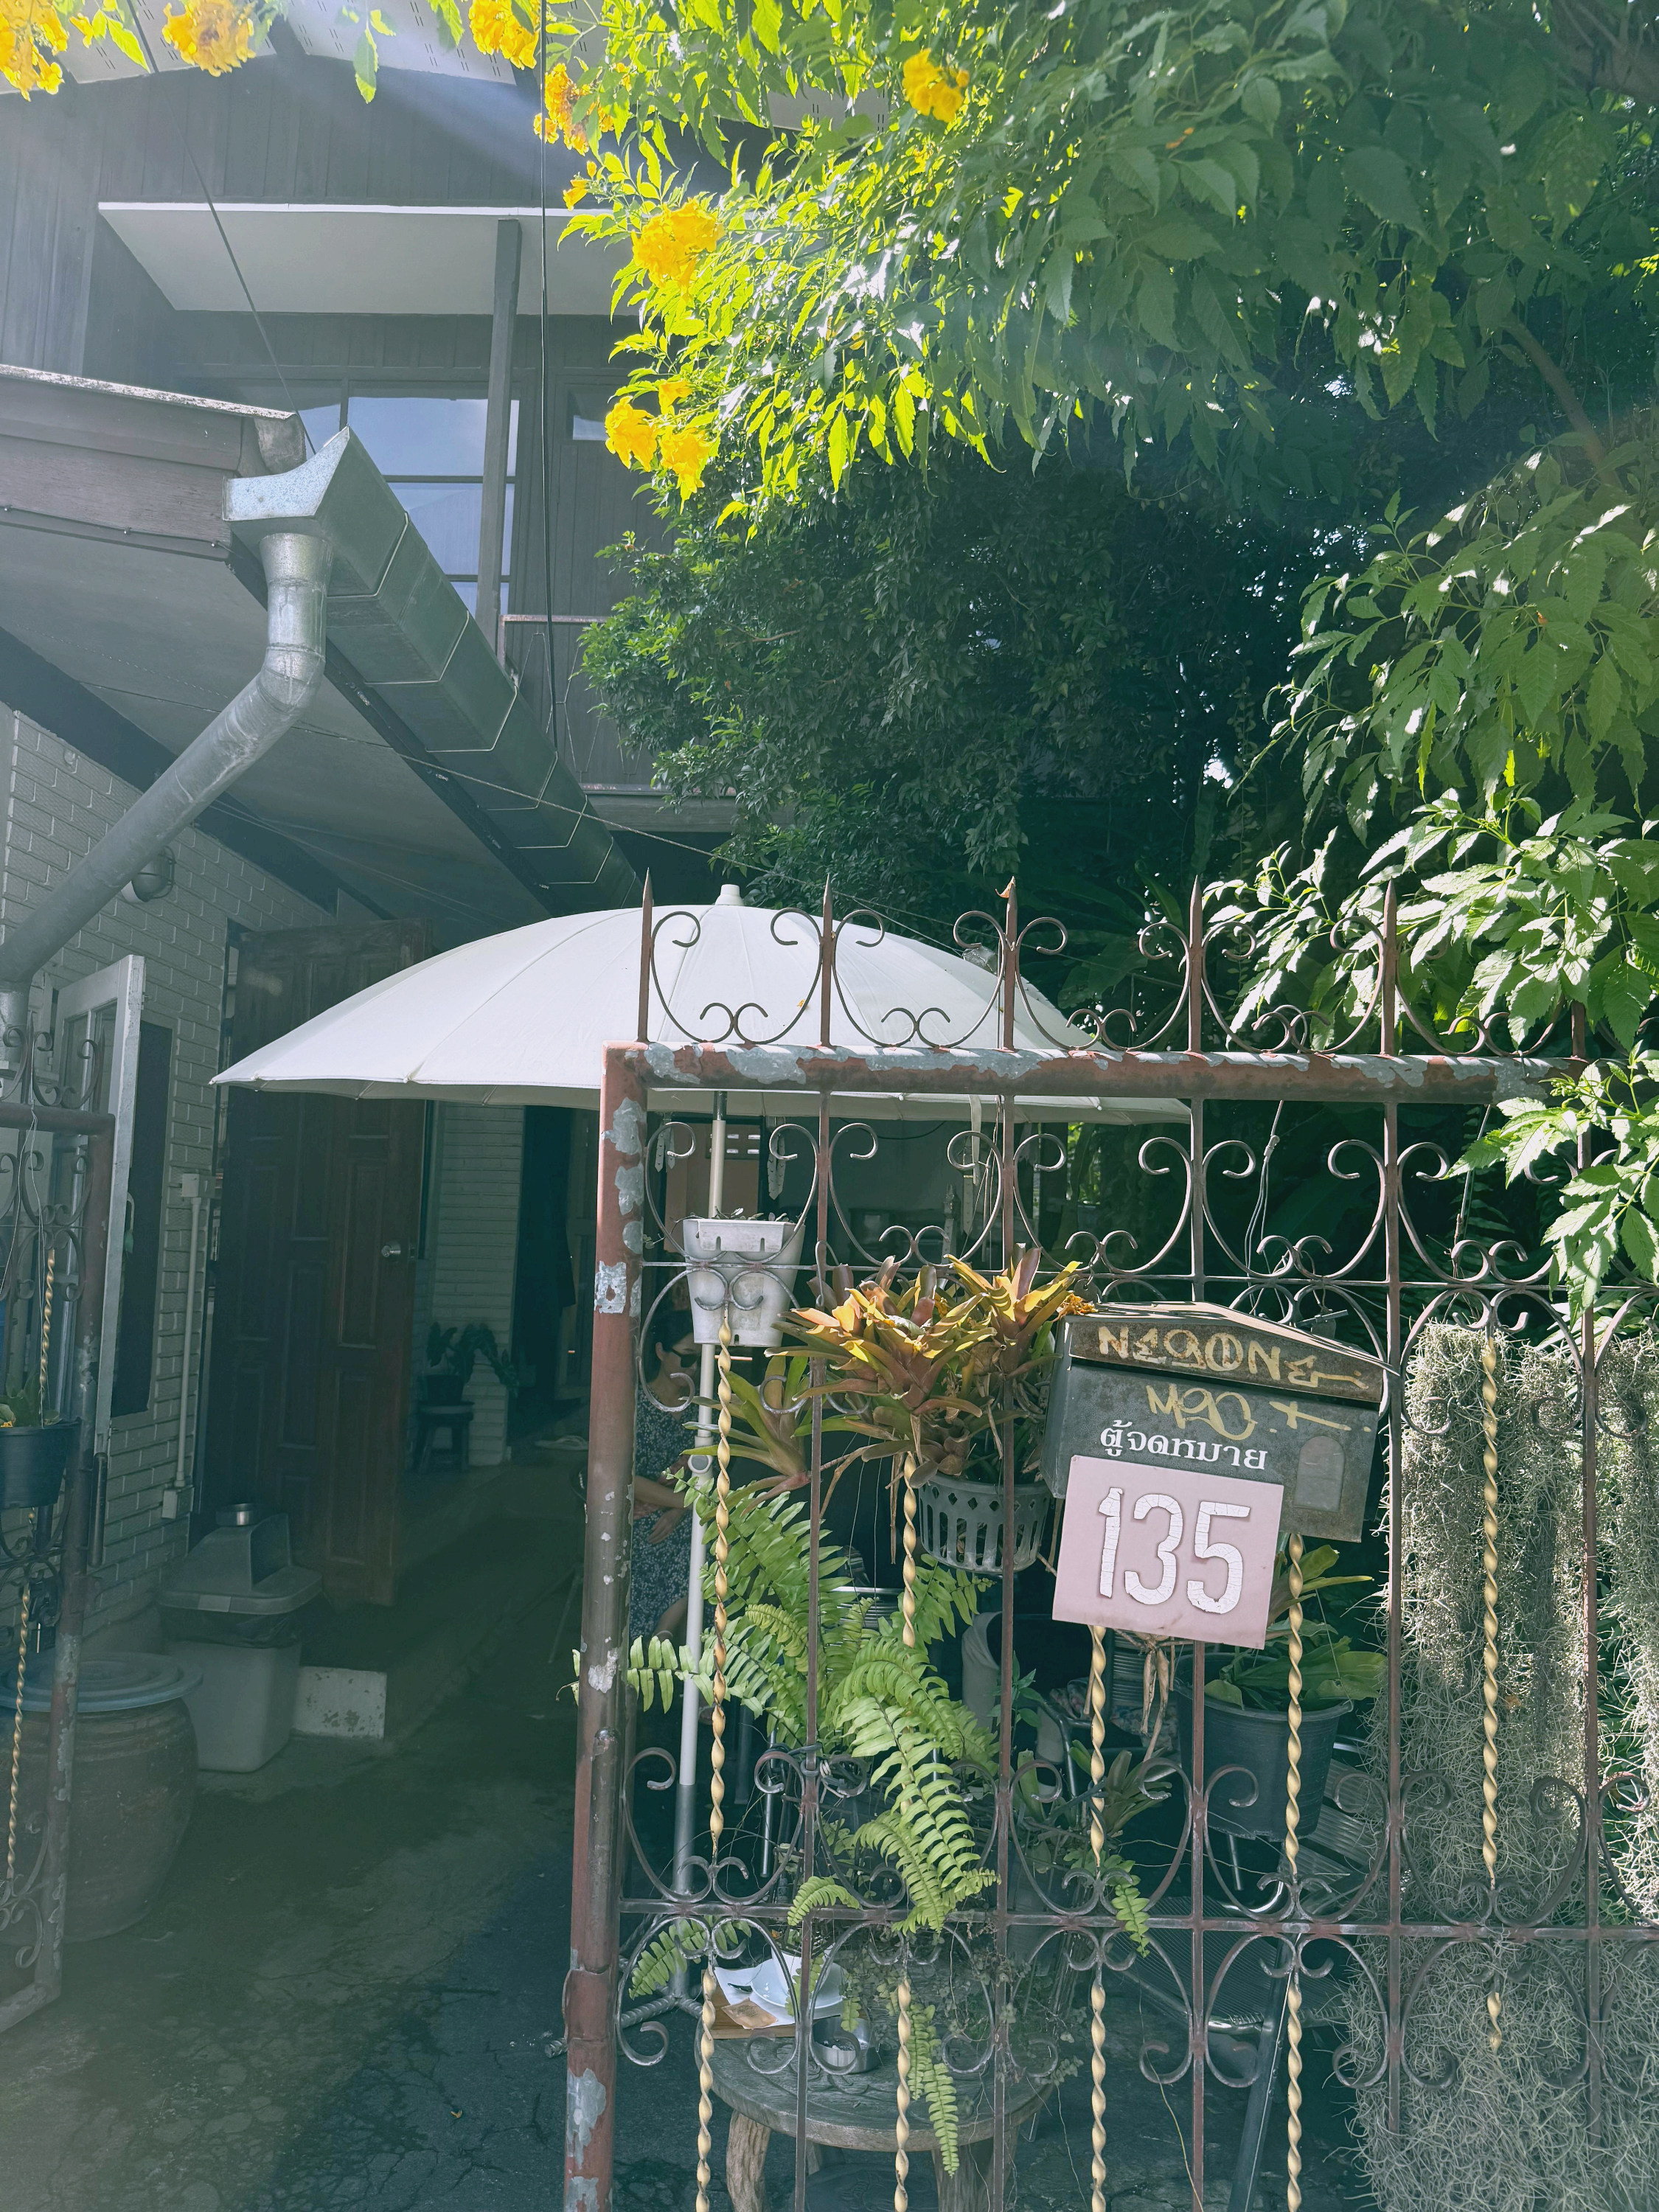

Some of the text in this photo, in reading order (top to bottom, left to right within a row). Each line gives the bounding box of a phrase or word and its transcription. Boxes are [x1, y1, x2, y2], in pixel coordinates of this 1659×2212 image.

[1100, 1419, 1268, 1470] ตู้จดหมาย
[1099, 1487, 1251, 1615] 135
